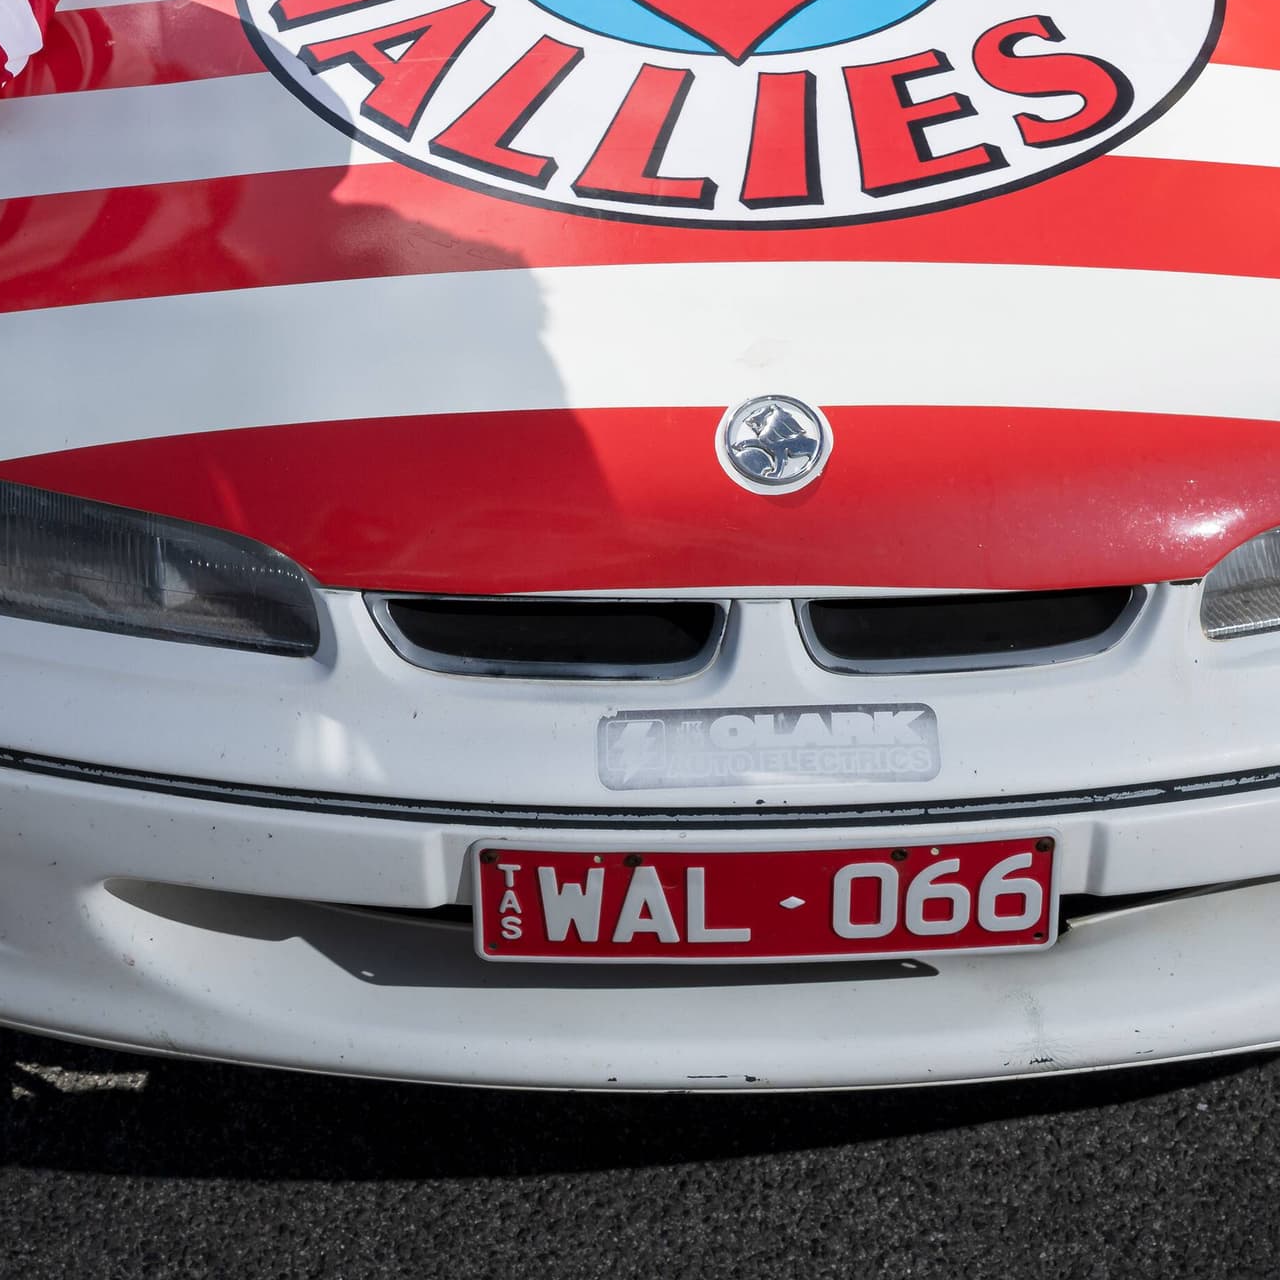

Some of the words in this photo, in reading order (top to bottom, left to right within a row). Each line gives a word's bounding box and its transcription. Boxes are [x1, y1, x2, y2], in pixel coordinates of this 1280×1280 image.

[497, 863, 523, 941] TAS
[537, 865, 752, 944] WAL
[832, 852, 1044, 941] 066
